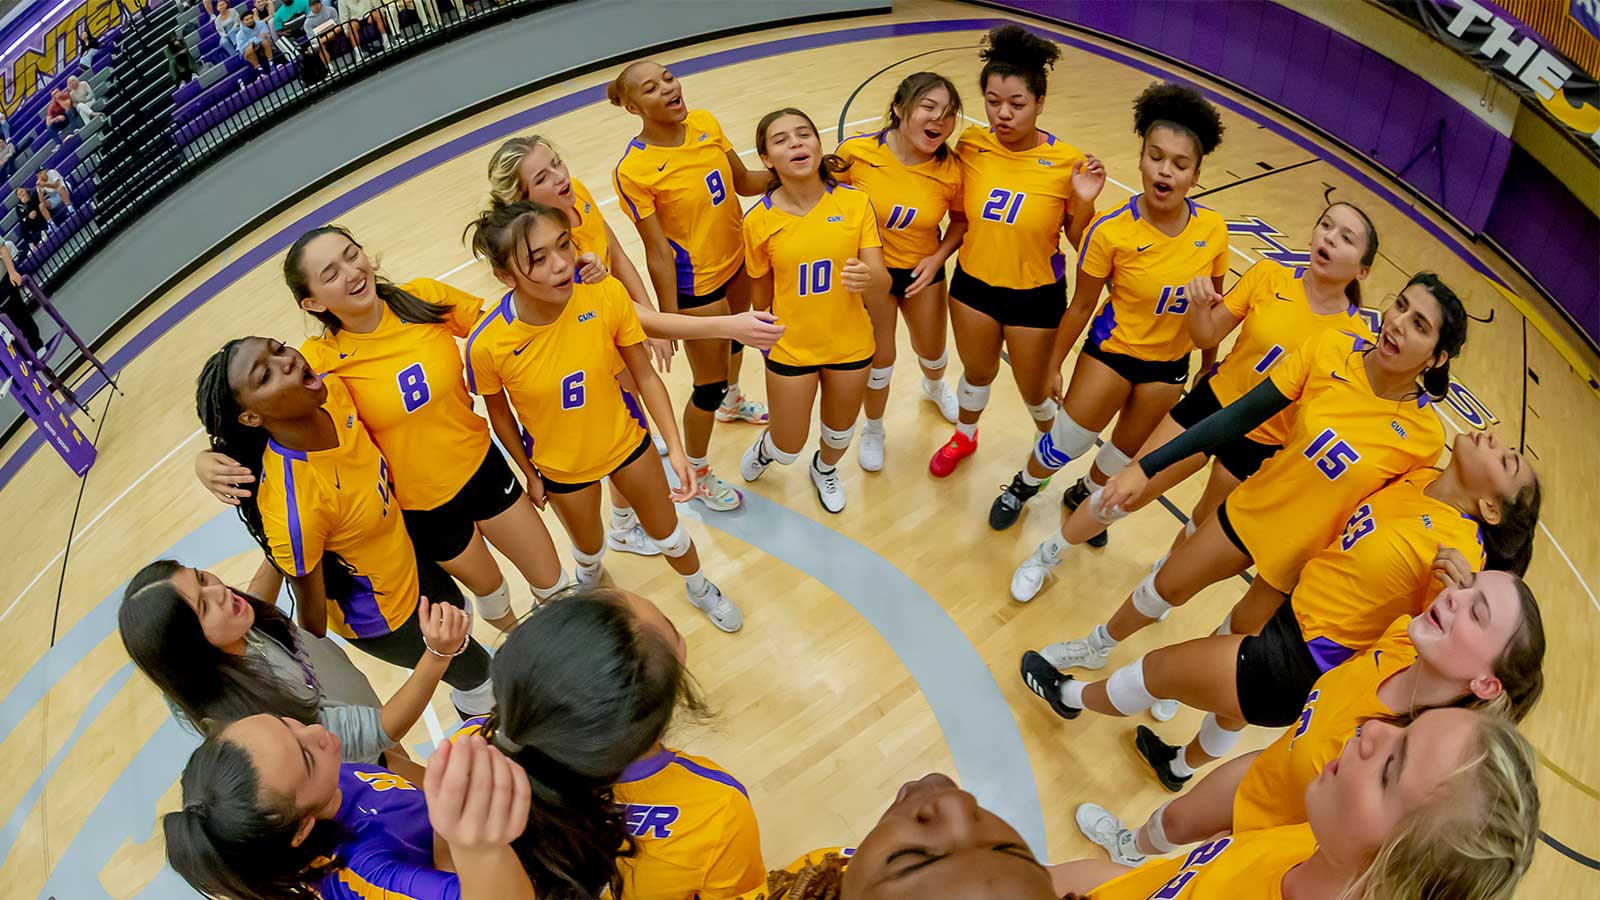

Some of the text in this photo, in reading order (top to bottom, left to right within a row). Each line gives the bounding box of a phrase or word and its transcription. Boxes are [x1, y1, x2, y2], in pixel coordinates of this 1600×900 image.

[1447, 0, 1573, 101] THE
[704, 169, 727, 207] 9
[981, 188, 1027, 225] 21
[886, 205, 918, 231] 11
[798, 259, 833, 297] 10
[577, 310, 597, 323] CUN
[397, 362, 431, 414] 8
[561, 369, 586, 411] 6
[1391, 420, 1409, 439] CUN
[1303, 428, 1361, 481] 15
